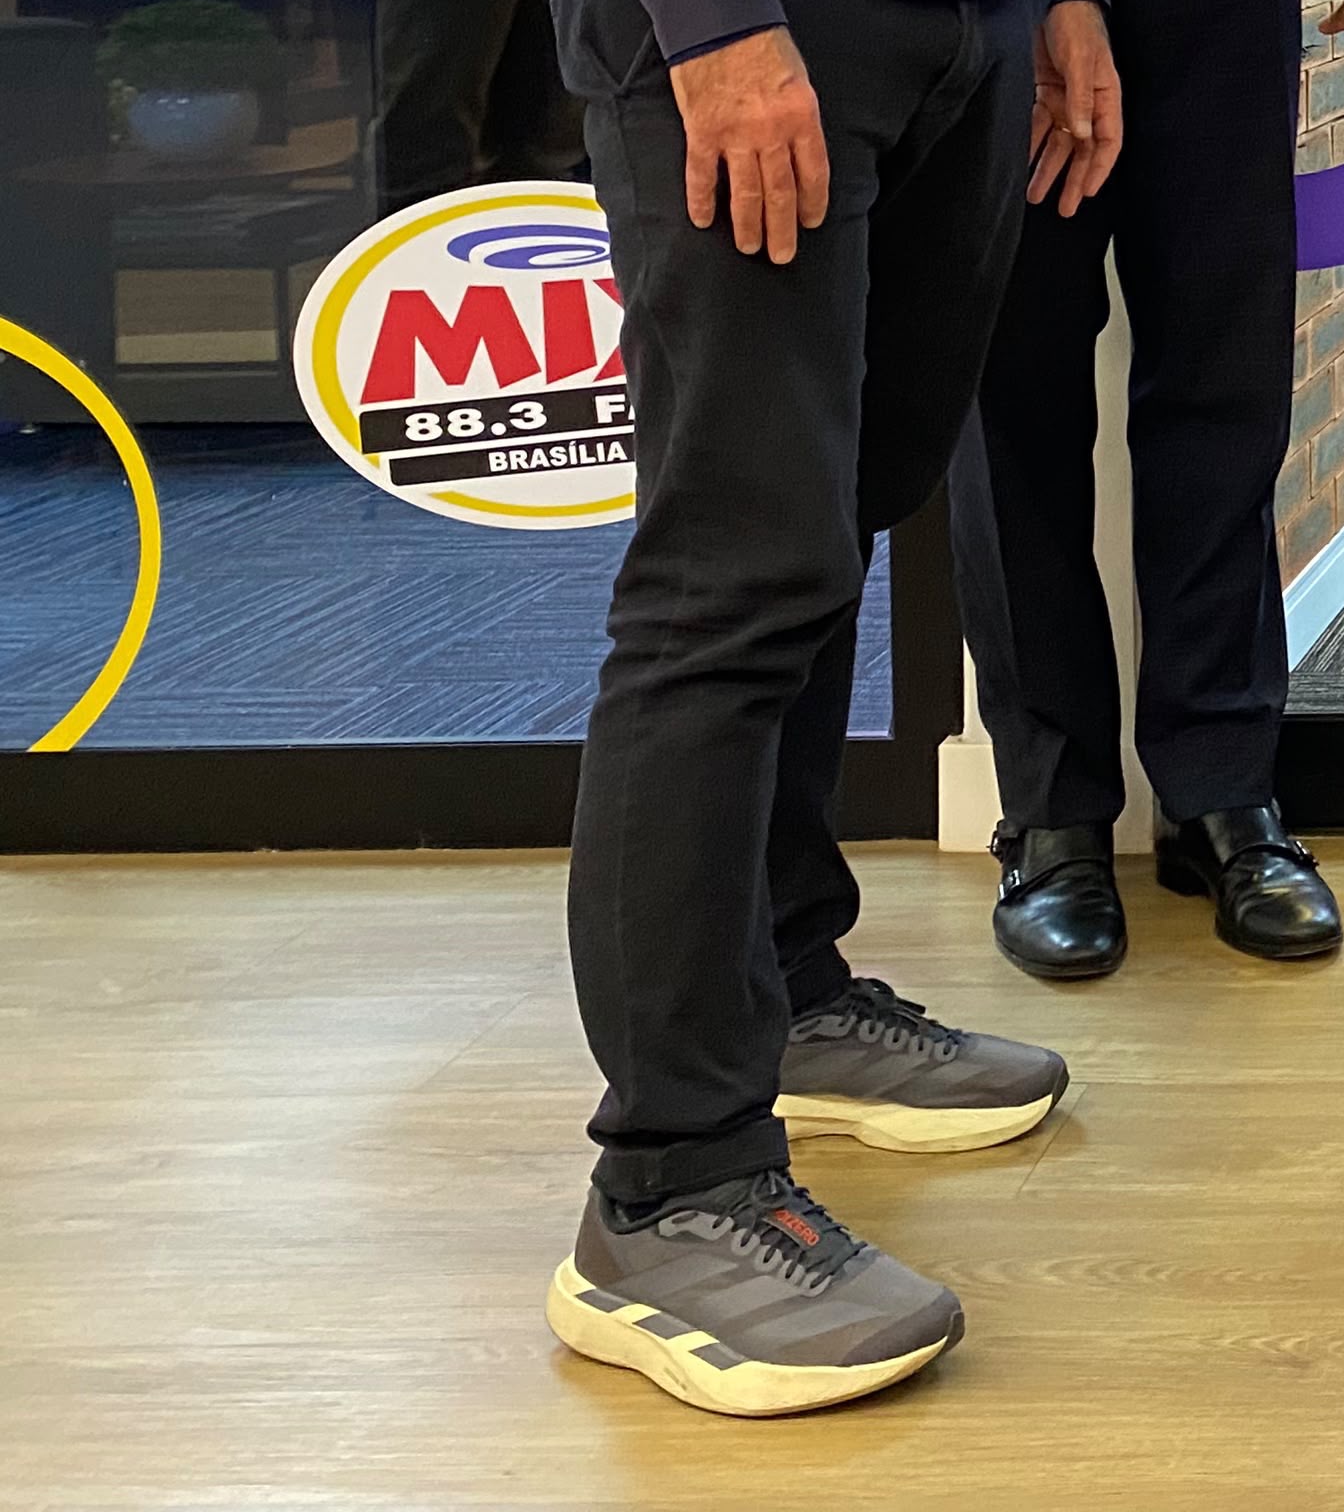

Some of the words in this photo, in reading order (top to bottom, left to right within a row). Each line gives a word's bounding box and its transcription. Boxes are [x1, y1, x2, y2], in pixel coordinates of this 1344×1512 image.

[404, 400, 548, 442] 88.3
[595, 393, 635, 424] F
[488, 440, 628, 473] BRASÍLIA
